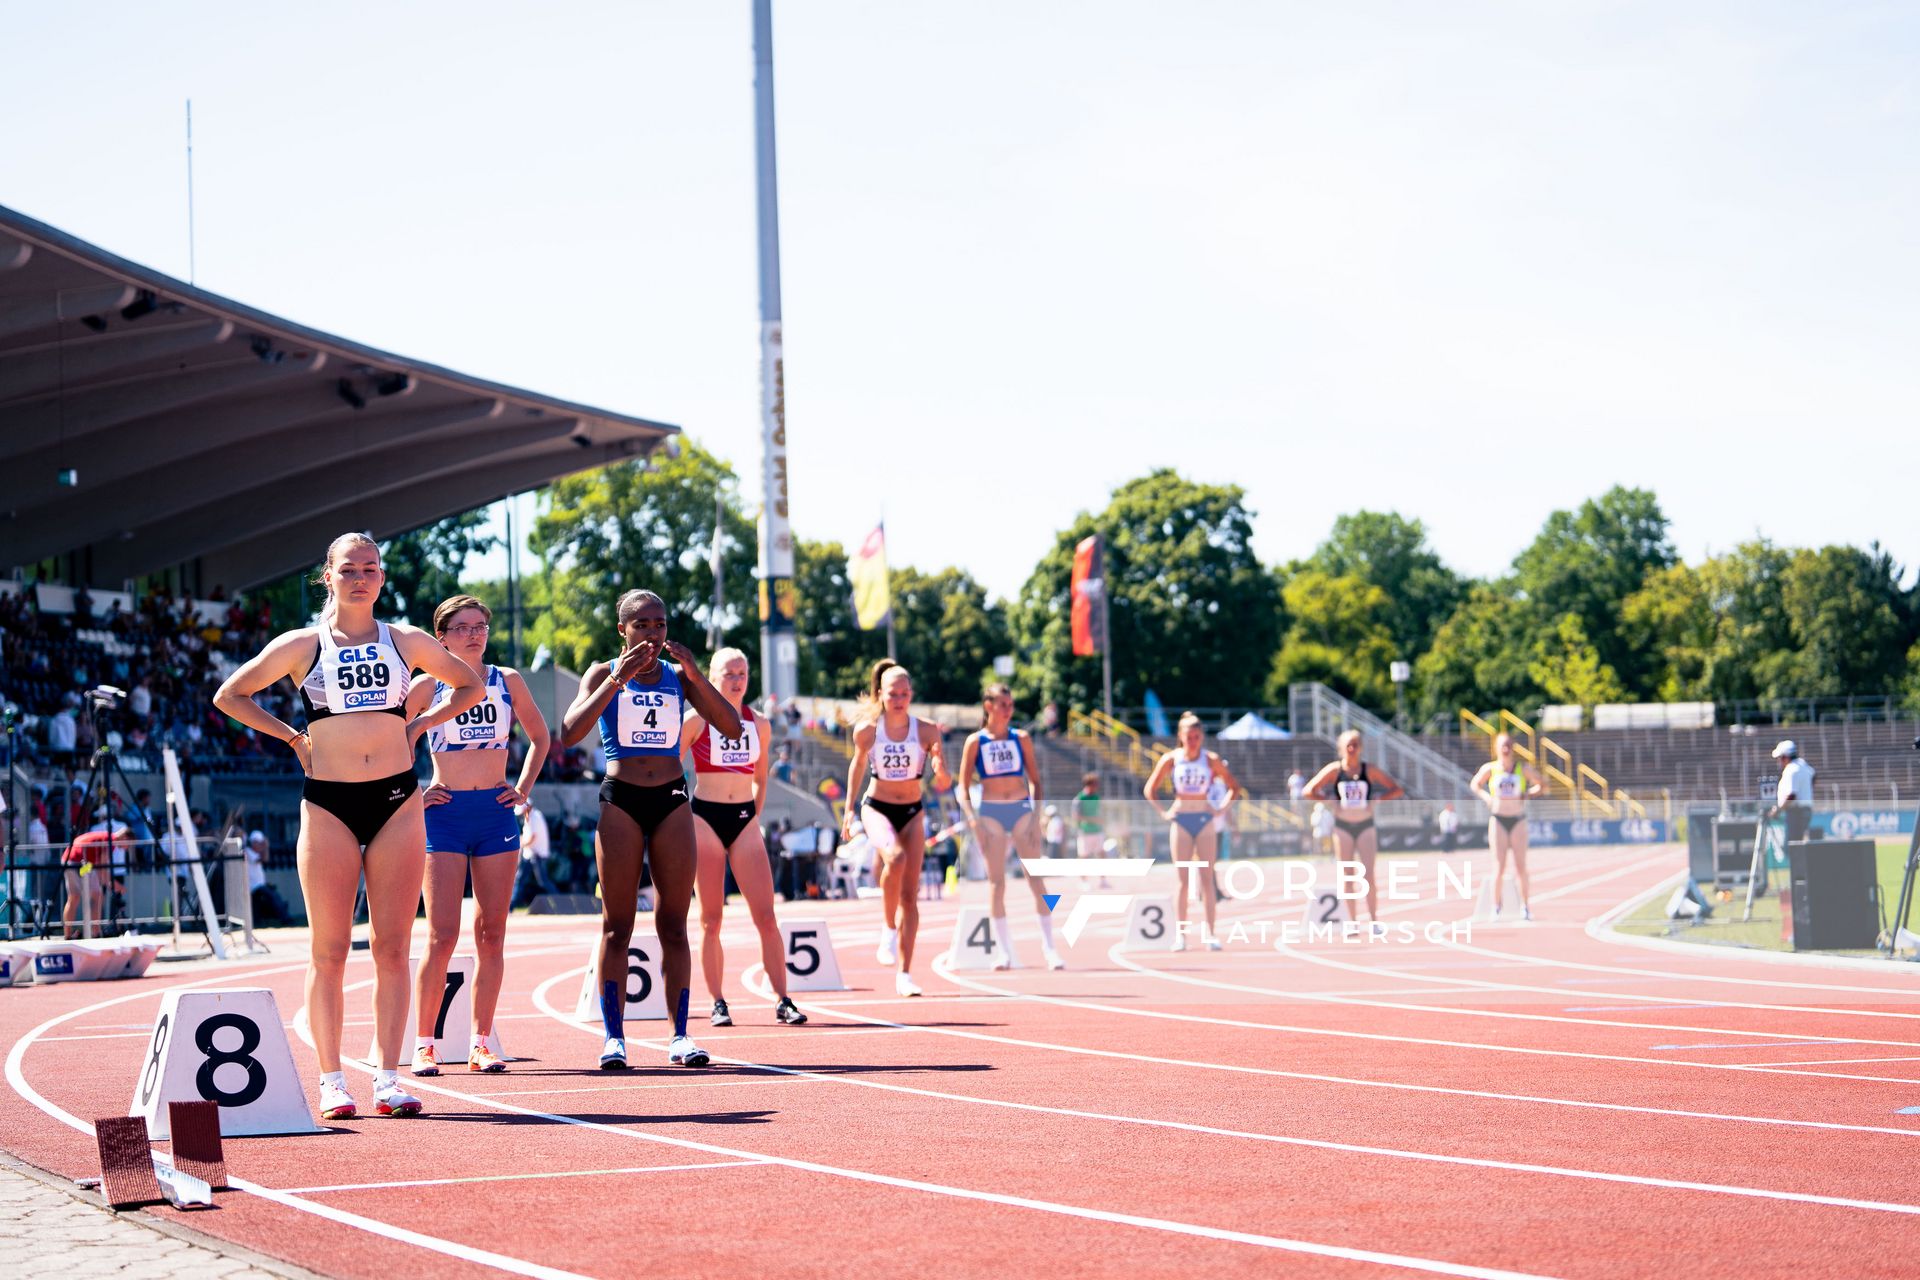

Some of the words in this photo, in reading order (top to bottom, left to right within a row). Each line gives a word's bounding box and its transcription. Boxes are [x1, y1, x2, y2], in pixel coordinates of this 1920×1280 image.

[337, 662, 390, 690] 589
[362, 692, 386, 701] PLAN
[474, 728, 494, 737] PLAN
[643, 708, 657, 729] 4
[882, 755, 911, 768] 233
[1140, 905, 1166, 940] 3
[1319, 894, 1341, 923] 2
[785, 930, 820, 976] 5
[966, 917, 996, 954] 4
[624, 947, 652, 1003] 6
[433, 971, 465, 1040] 7
[141, 1013, 168, 1106] 8
[195, 1013, 267, 1108] 8
